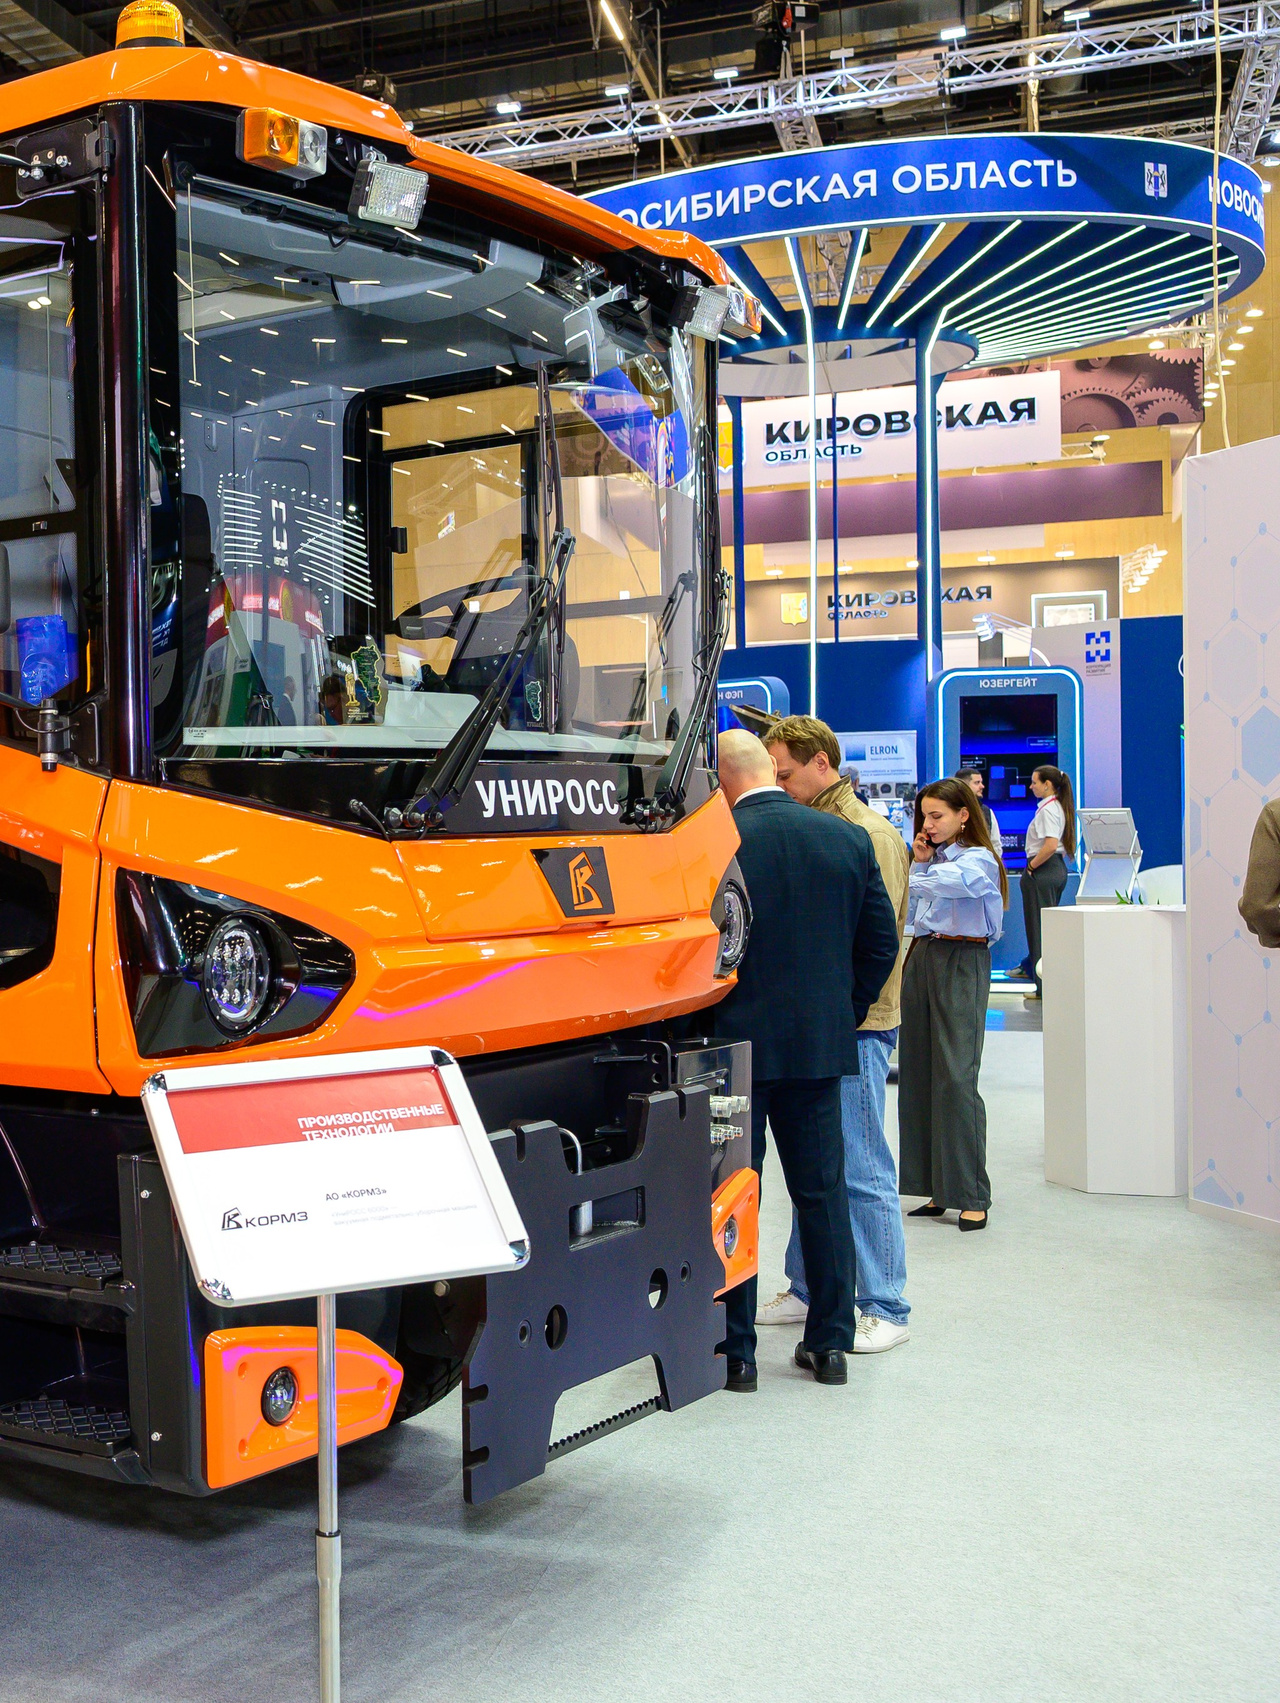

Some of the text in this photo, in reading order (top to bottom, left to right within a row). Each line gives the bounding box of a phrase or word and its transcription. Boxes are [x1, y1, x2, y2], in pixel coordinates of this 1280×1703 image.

[892, 159, 1077, 194] ОБЛАСТЬ
[765, 444, 862, 464] ОБЛАСТЬ
[827, 585, 992, 609] КИРОВКАЯ
[980, 677, 1037, 688] ЮЗЕРГЕЙТ
[725, 690, 743, 699] ФЭП
[870, 745, 898, 755] ELRON
[474, 779, 620, 818] УНИРОСС
[297, 1103, 445, 1129] ПРОИЗВОДСТВЕННЫЕ
[301, 1122, 395, 1142] ТЕХНОЛОГИИ
[325, 1187, 387, 1201] АО «КОРМЗ»
[245, 1211, 308, 1228] КОРМЗ
